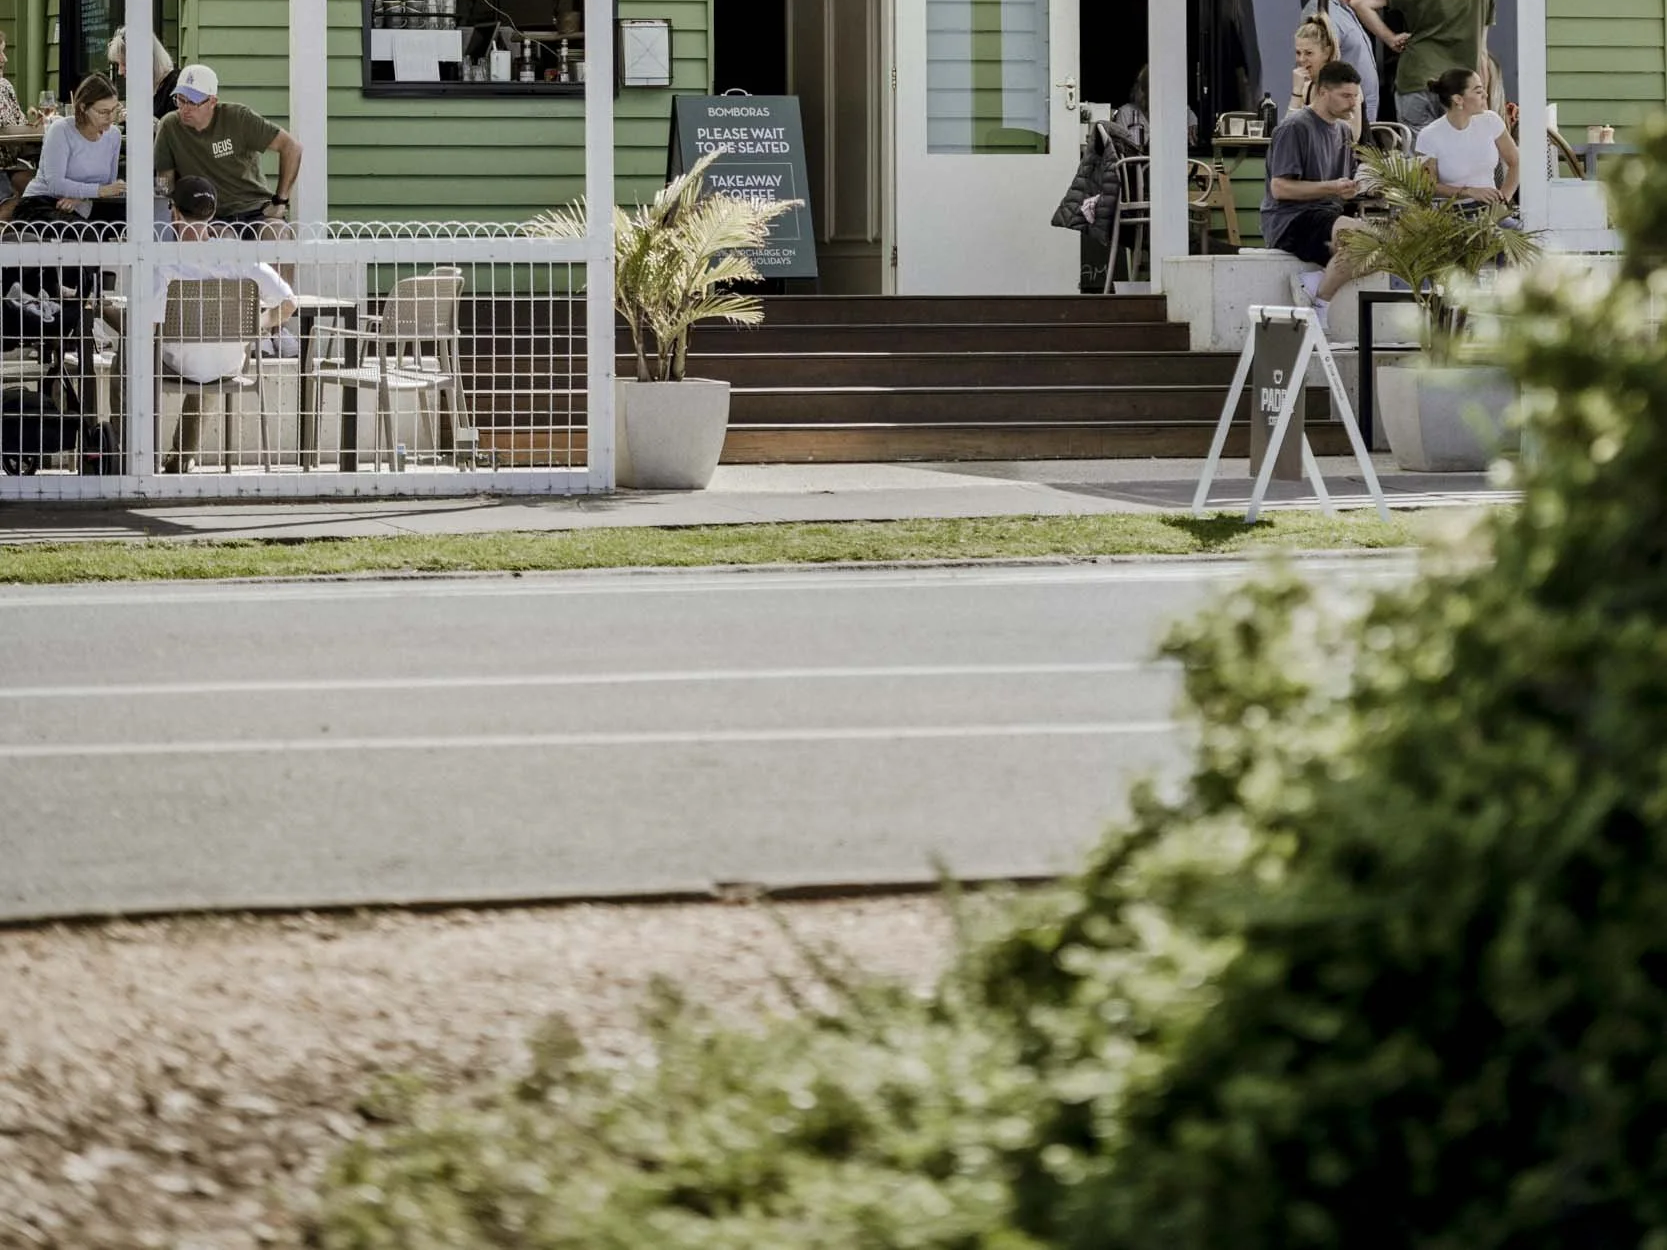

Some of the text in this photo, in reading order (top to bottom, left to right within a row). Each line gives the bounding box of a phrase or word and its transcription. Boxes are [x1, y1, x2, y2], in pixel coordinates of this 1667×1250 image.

[707, 107, 770, 117] BOMBORAS
[697, 127, 785, 140] PLEASE WAIT
[212, 138, 233, 155] DEUS
[695, 141, 790, 154] TO BE SEATED
[709, 174, 783, 187] TAKEAWAY
[720, 188, 776, 201] COFFEE
[782, 248, 796, 257] ON
[750, 256, 792, 265] HOLIDAYS
